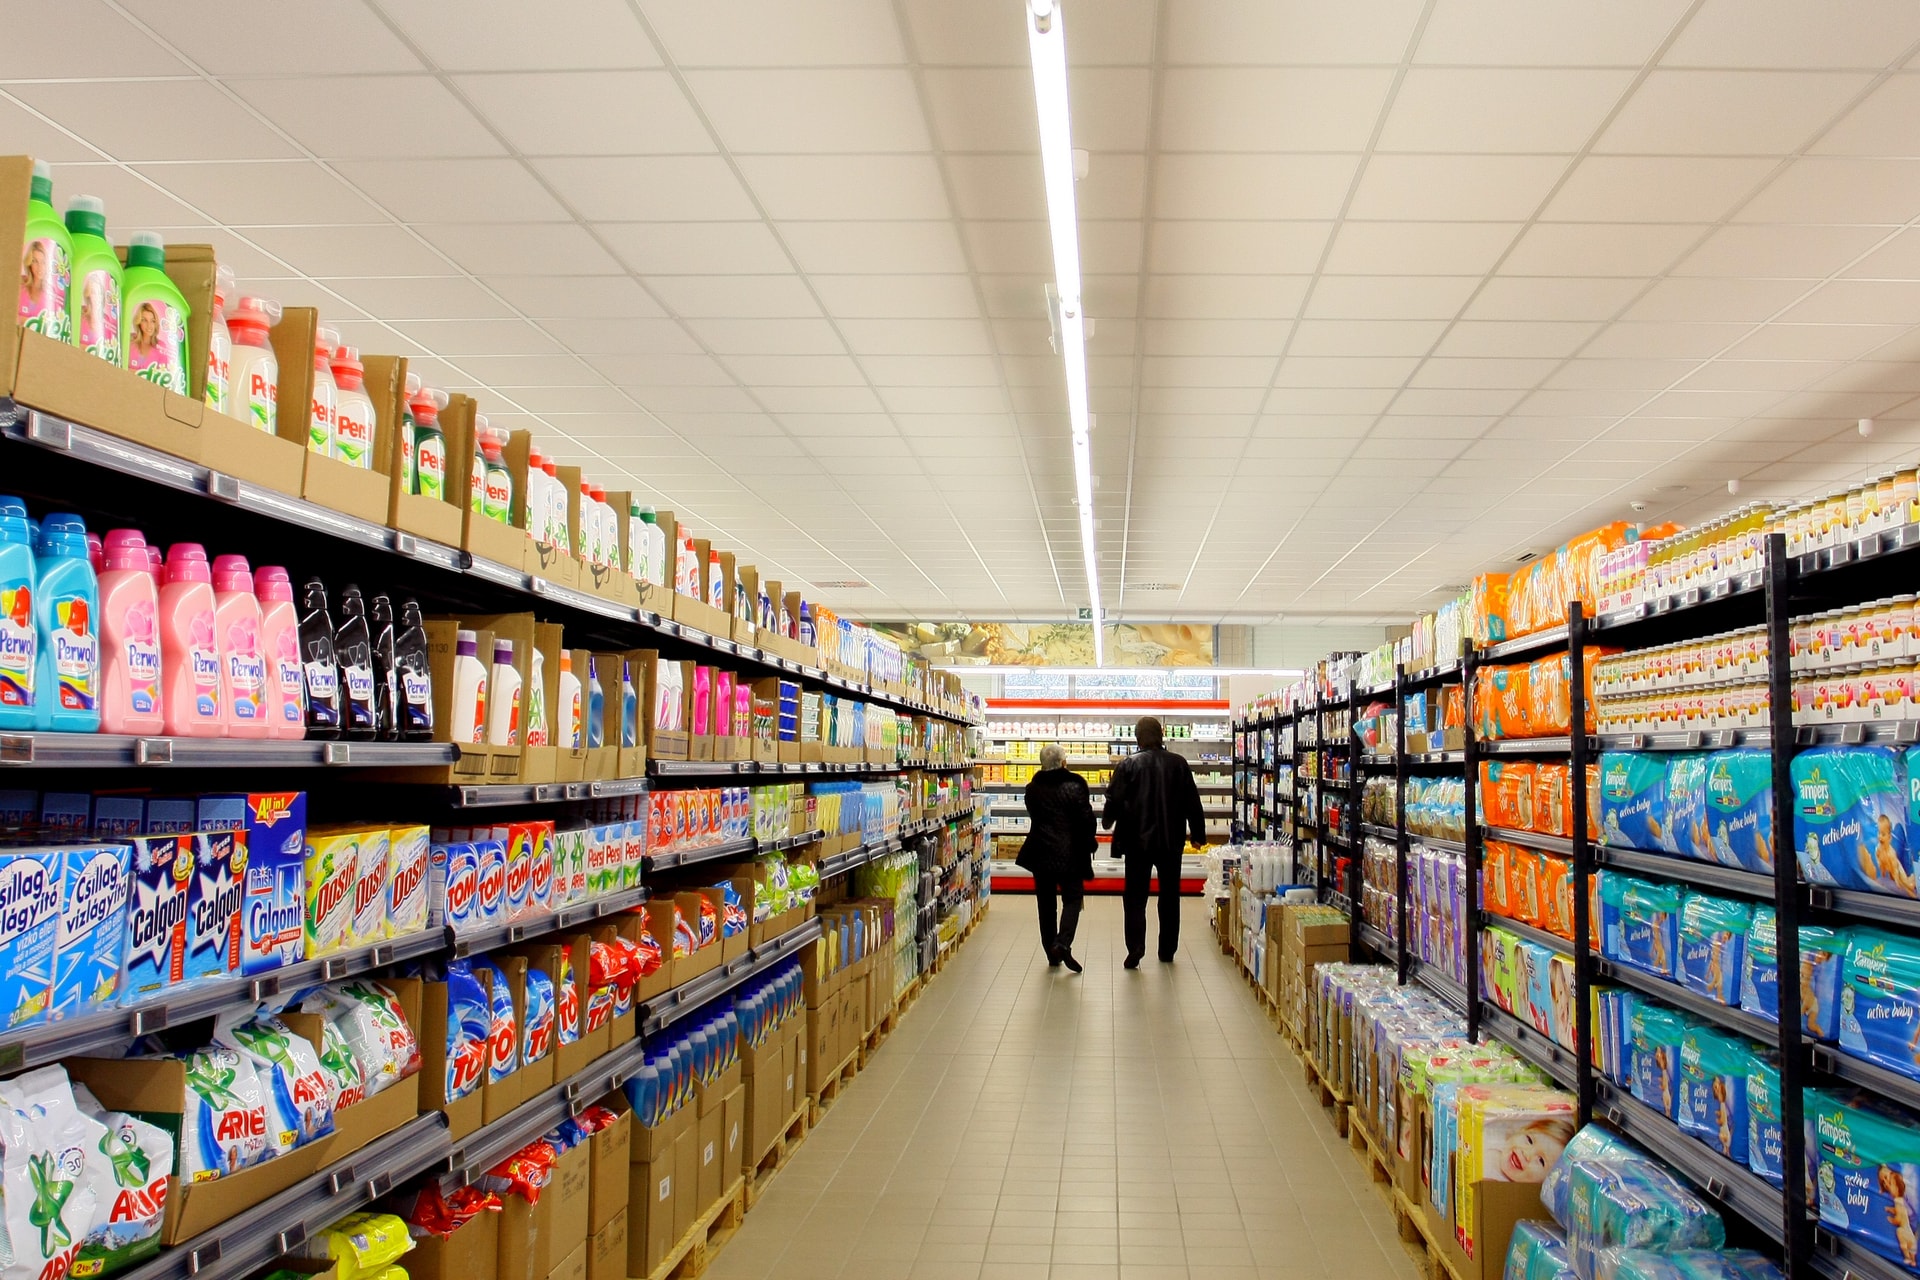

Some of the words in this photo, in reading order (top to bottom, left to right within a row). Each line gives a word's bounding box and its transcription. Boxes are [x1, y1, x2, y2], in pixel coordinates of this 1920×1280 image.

[58, 637, 96, 662] Perwoll
[1840, 818, 1861, 840] baby
[76, 862, 118, 903] Csillag
[315, 855, 357, 926] DOSIA
[355, 851, 388, 919] DOSIA
[392, 846, 428, 912] DOSIA
[132, 890, 186, 949] Calgon
[196, 882, 241, 937] Calgon
[249, 896, 302, 943] Calgonit
[1867, 1003, 1890, 1019] active
[1891, 1001, 1914, 1025] baby
[1694, 1099, 1707, 1118] baby
[1818, 1113, 1852, 1146] Pampers
[109, 1174, 171, 1224] ARIE
[1844, 1171, 1870, 1189] active
[1847, 1188, 1869, 1214] baby
